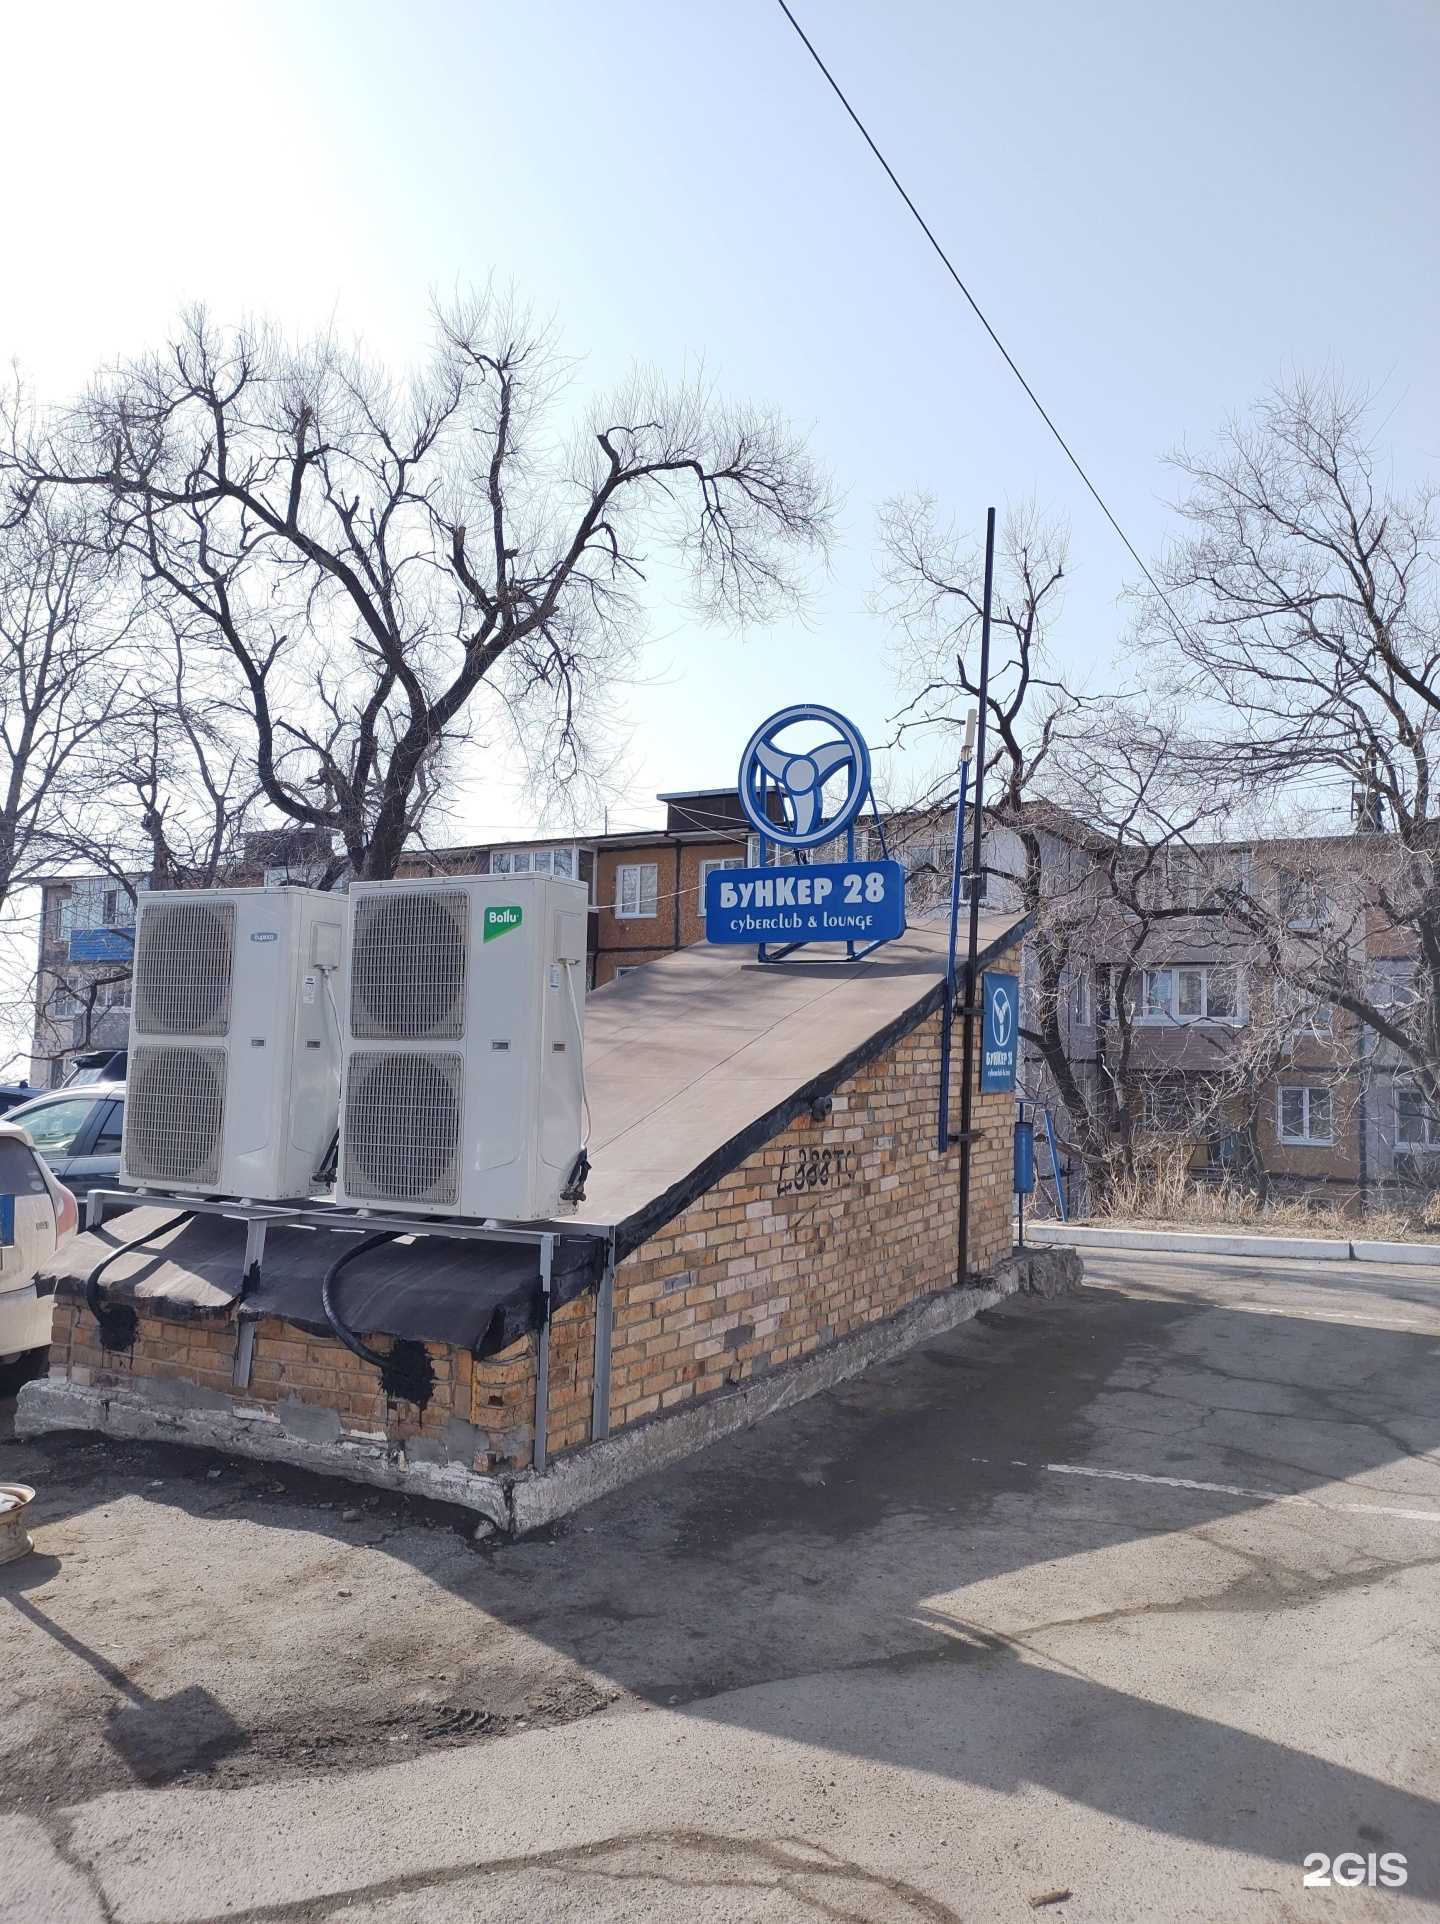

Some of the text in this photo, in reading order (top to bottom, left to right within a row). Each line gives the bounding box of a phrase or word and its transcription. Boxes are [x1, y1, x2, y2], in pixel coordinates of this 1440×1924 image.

[843, 872, 885, 904] 28
[489, 908, 517, 923] Ballu
[730, 912, 803, 933] cyberclub
[807, 915, 818, 928] &
